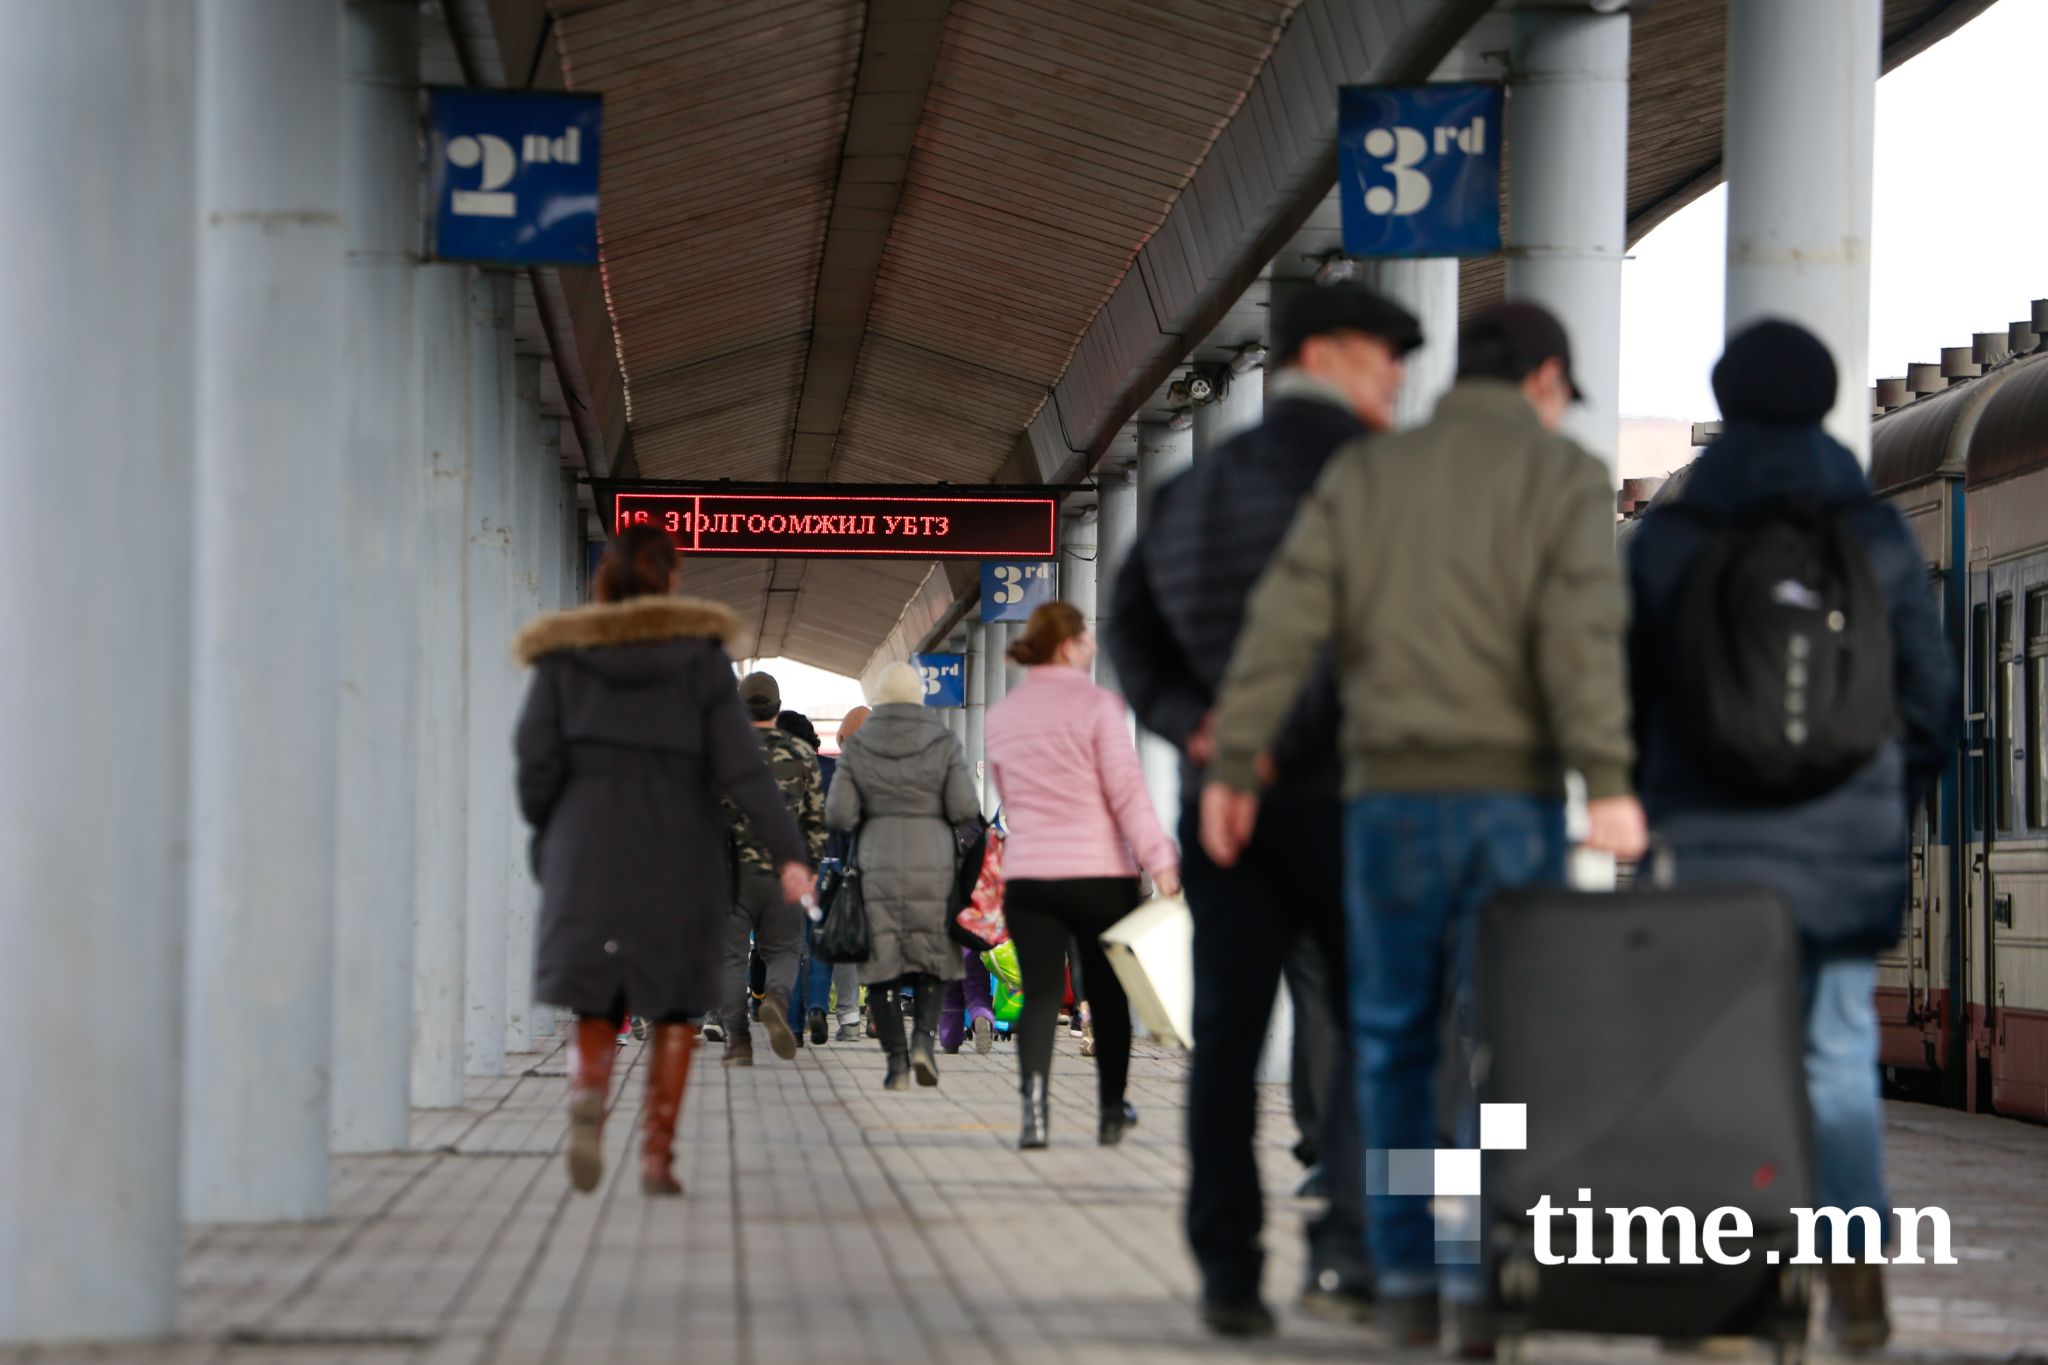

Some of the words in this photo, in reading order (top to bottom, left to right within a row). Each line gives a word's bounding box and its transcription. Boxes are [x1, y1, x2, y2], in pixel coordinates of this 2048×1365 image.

[447, 126, 581, 217] 2nd
[1364, 115, 1486, 216] 3rd
[882, 515, 949, 536] УБТЗ
[993, 561, 1049, 605] 3rd
[920, 663, 959, 695] 3rd
